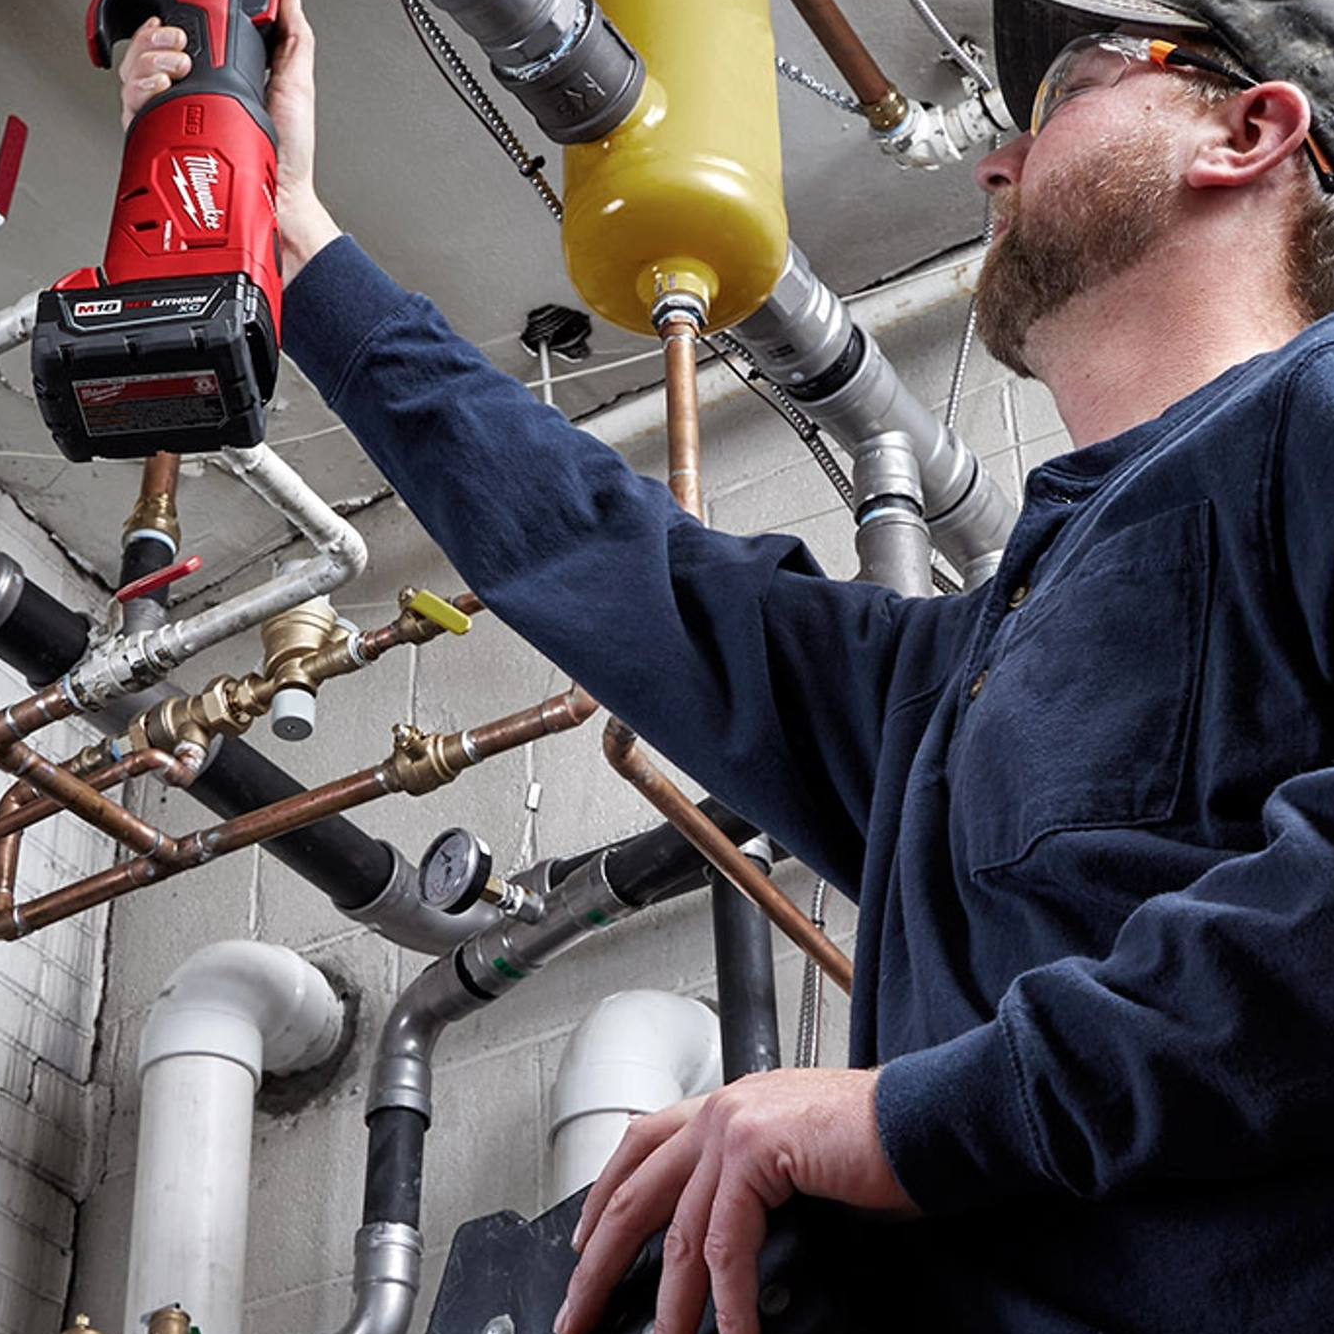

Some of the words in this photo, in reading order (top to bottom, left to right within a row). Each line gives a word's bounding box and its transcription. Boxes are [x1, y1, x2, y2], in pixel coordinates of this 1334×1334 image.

[183, 154, 225, 229] Milwaukee
[77, 302, 119, 314] M18
[124, 296, 207, 309] REDLITHIUM
